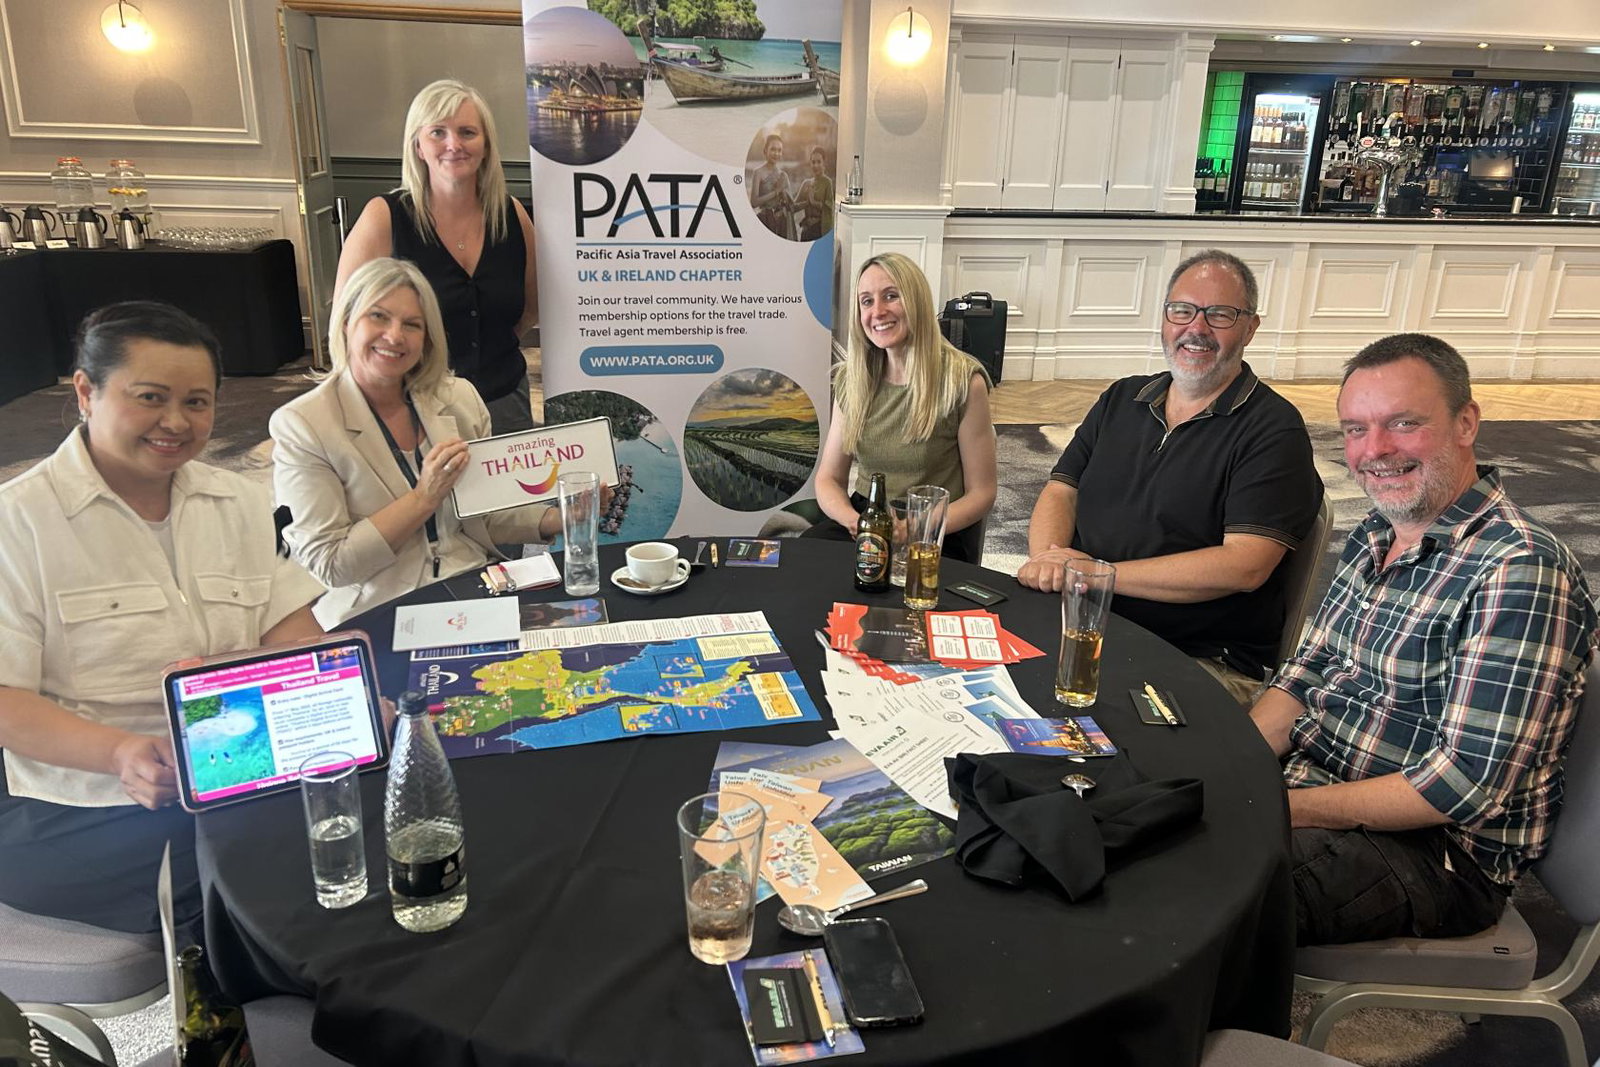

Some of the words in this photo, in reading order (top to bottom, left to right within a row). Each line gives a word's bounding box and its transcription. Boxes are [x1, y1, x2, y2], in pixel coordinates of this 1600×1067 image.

[576, 249, 612, 260] Pacific
[616, 249, 640, 260] Asia
[642, 249, 676, 260] Travel
[679, 249, 743, 260] Association
[578, 270, 598, 282] UK
[601, 270, 612, 282] &
[615, 270, 676, 282] IRELAND
[679, 269, 742, 282] CHAPTER
[578, 295, 600, 306] Join
[603, 297, 621, 305] our
[623, 294, 653, 305] travel
[655, 294, 718, 306] community.
[721, 294, 738, 304] We
[740, 294, 764, 304] have
[766, 294, 802, 304] various
[579, 310, 647, 322] membership
[649, 310, 689, 322] options
[691, 310, 706, 320] for
[708, 310, 725, 320] the
[727, 309, 756, 319] travel
[758, 309, 788, 319] trade.
[579, 326, 611, 337] Travel
[613, 327, 644, 338] agent
[646, 326, 713, 337] membership
[716, 325, 724, 335] is
[725, 325, 748, 335] free.
[590, 354, 715, 368] WWW.PATA.ORG.UK
[507, 437, 556, 454] amazing
[481, 444, 585, 477] THAILAND
